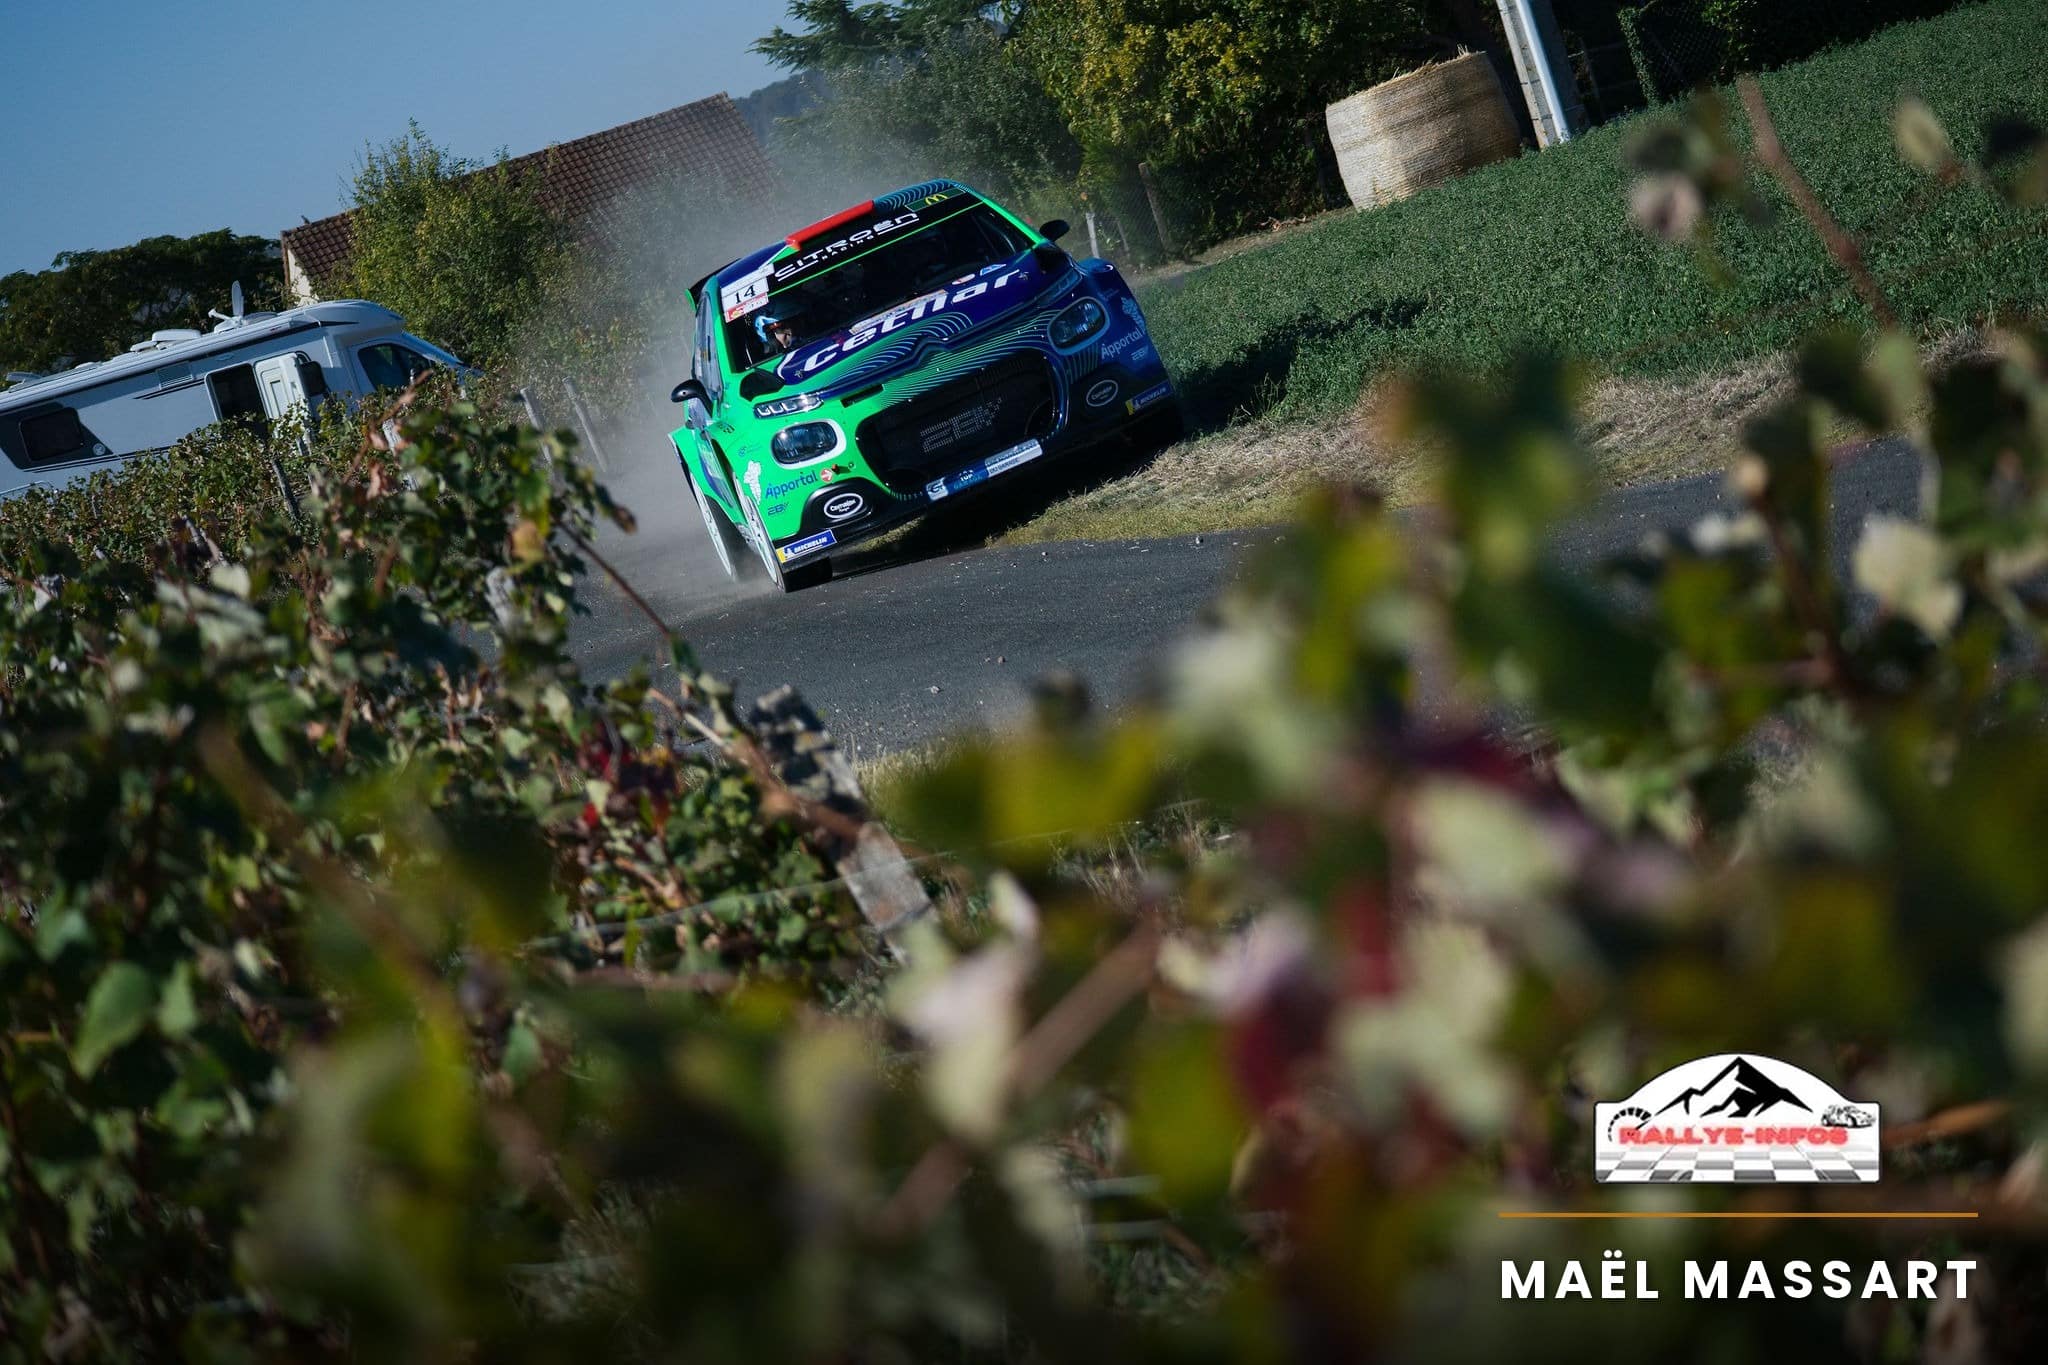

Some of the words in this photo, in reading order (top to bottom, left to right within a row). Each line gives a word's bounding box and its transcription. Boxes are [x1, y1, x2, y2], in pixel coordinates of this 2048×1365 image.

[736, 285, 756, 304] 14
[765, 470, 818, 499] Apportal
[794, 536, 828, 553] MICHELIN
